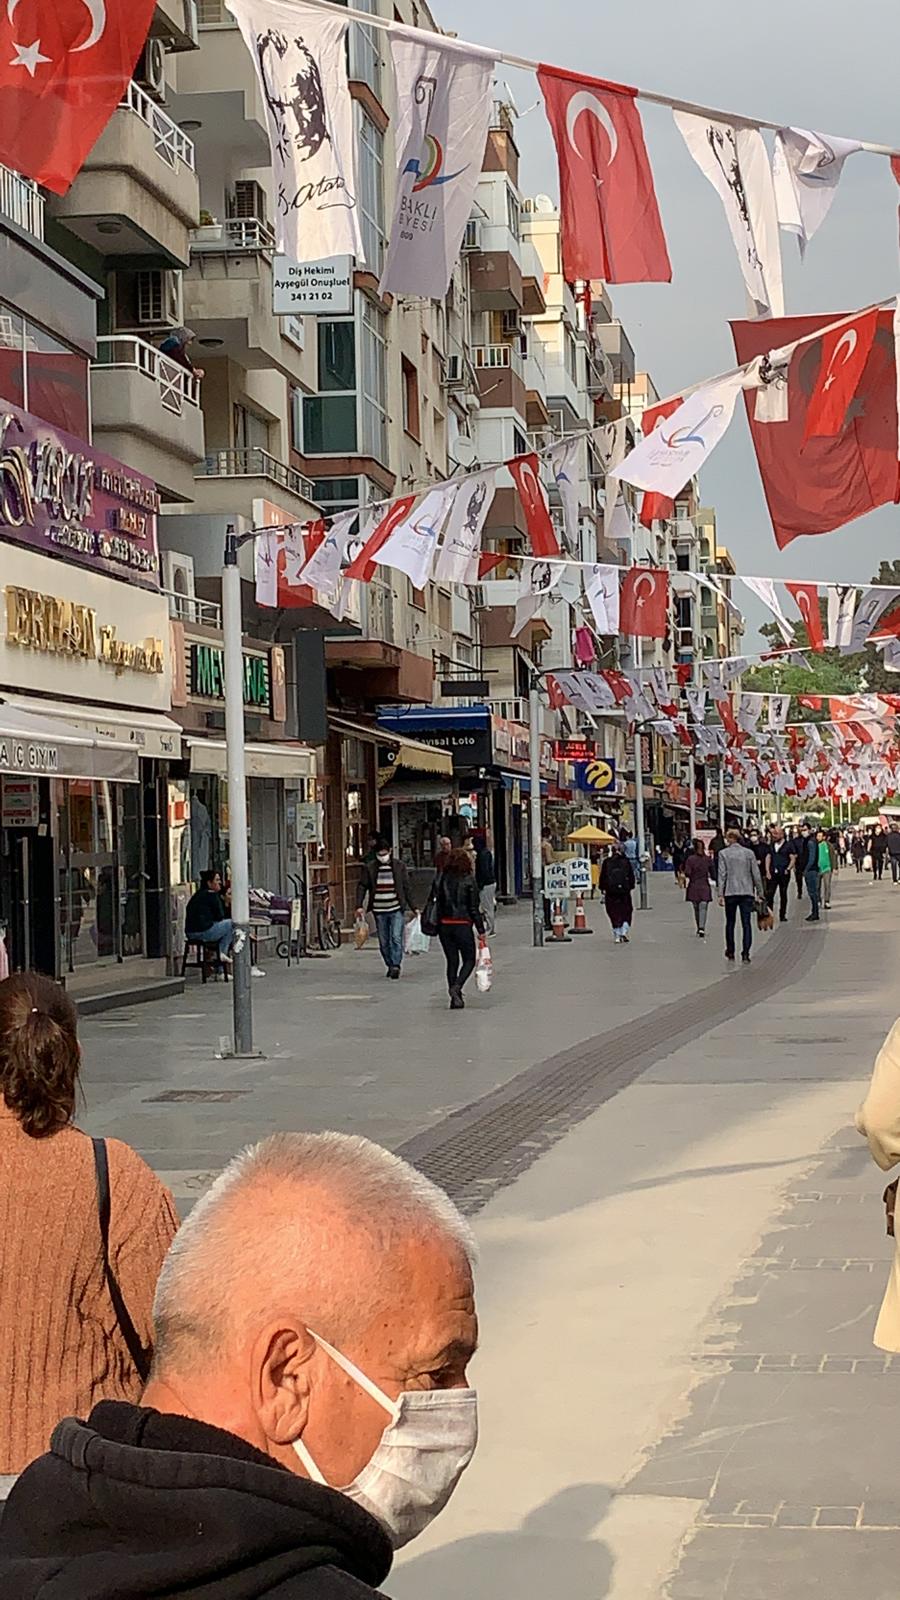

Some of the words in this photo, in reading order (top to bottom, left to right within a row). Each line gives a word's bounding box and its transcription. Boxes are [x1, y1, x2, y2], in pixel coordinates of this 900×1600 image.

[288, 267, 302, 276] Diş
[304, 266, 335, 275] Hekimi
[275, 279, 309, 290] Ayşegül
[291, 293, 307, 301] 341
[309, 292, 319, 300] 21
[321, 292, 333, 300] 02
[195, 644, 269, 705] MENA
[452, 736, 475, 745] Loto
[28, 743, 58, 770] GİYİM
[571, 861, 590, 871] EPE
